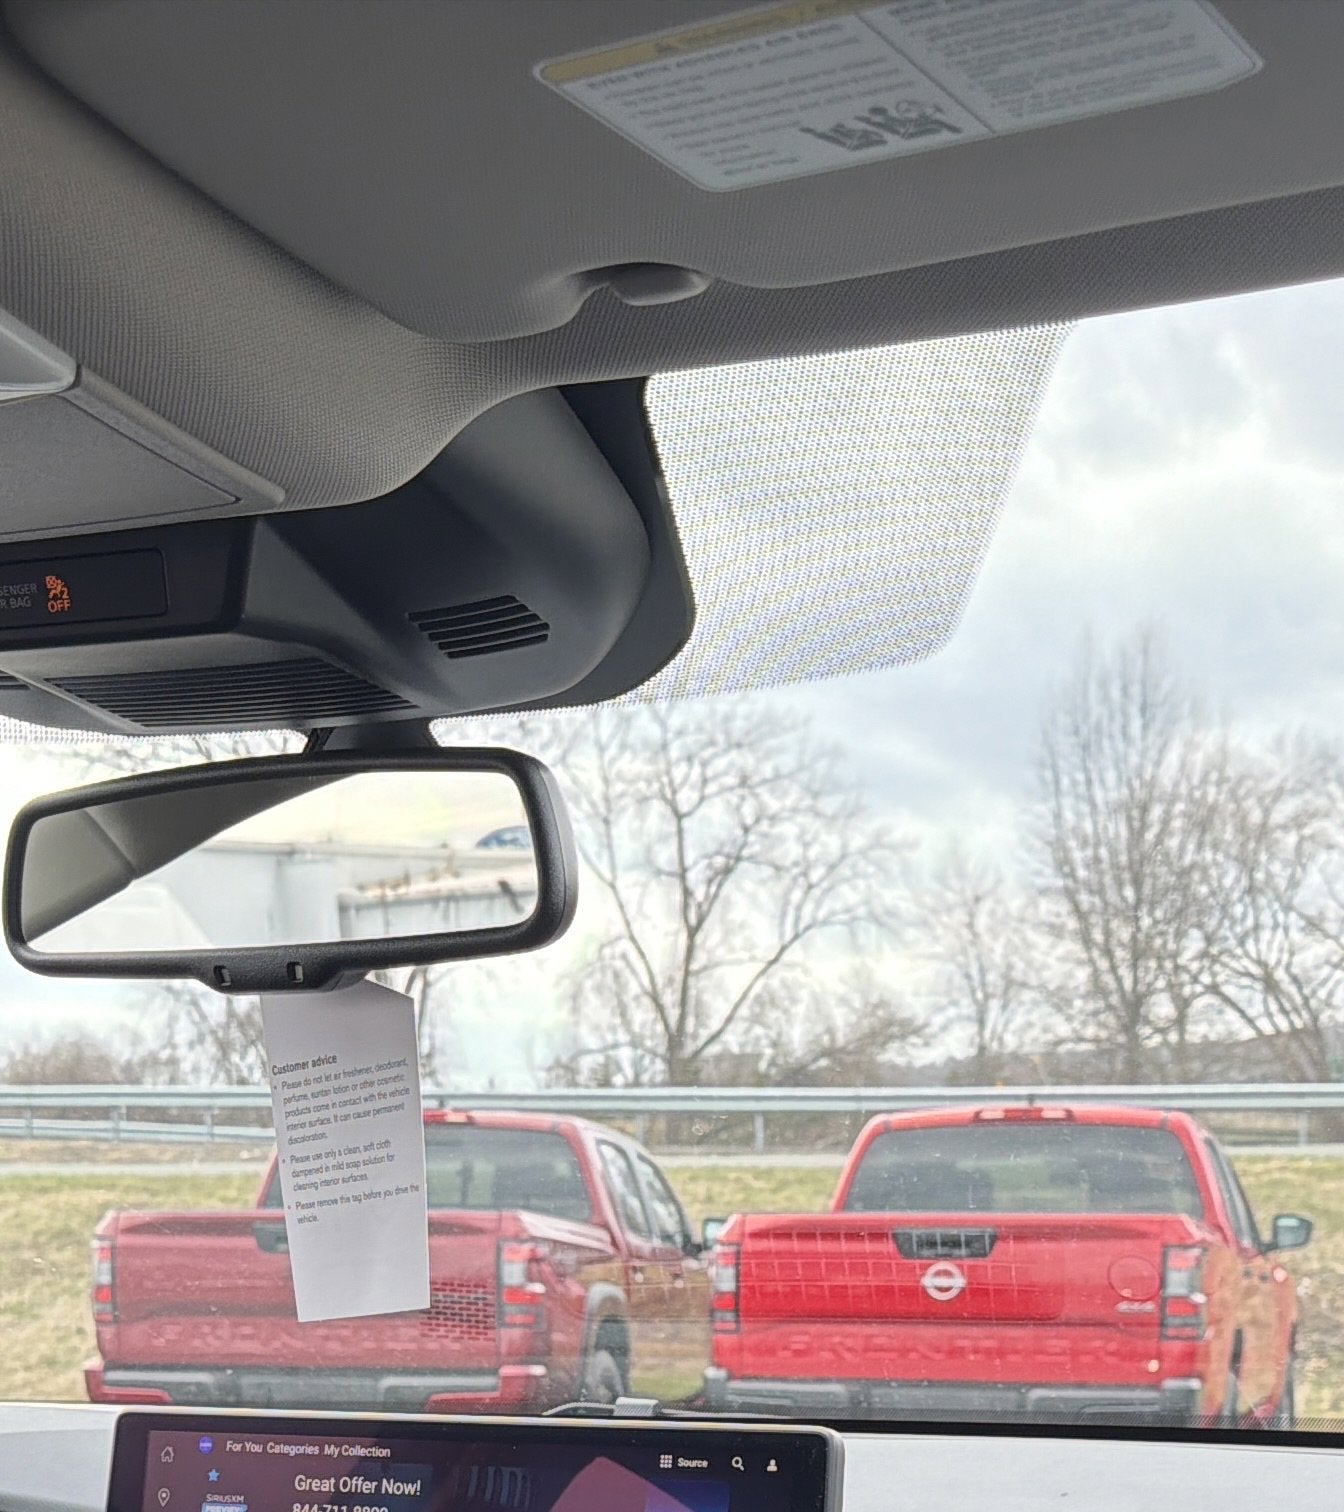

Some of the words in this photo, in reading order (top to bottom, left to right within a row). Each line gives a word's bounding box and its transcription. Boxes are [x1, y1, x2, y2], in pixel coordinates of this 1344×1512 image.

[11, 596, 32, 609] BAG
[47, 600, 71, 613] OFF
[272, 1060, 309, 1076] Customer
[311, 1053, 338, 1068] advice
[226, 1440, 243, 1452] For
[244, 1441, 263, 1453] You
[266, 1442, 319, 1456] Categories
[324, 1444, 339, 1458] My
[341, 1445, 391, 1458] Collection
[677, 1457, 708, 1469] Source
[294, 1475, 335, 1493] Great
[339, 1476, 378, 1494] Offer
[381, 1478, 421, 1496] Now!
